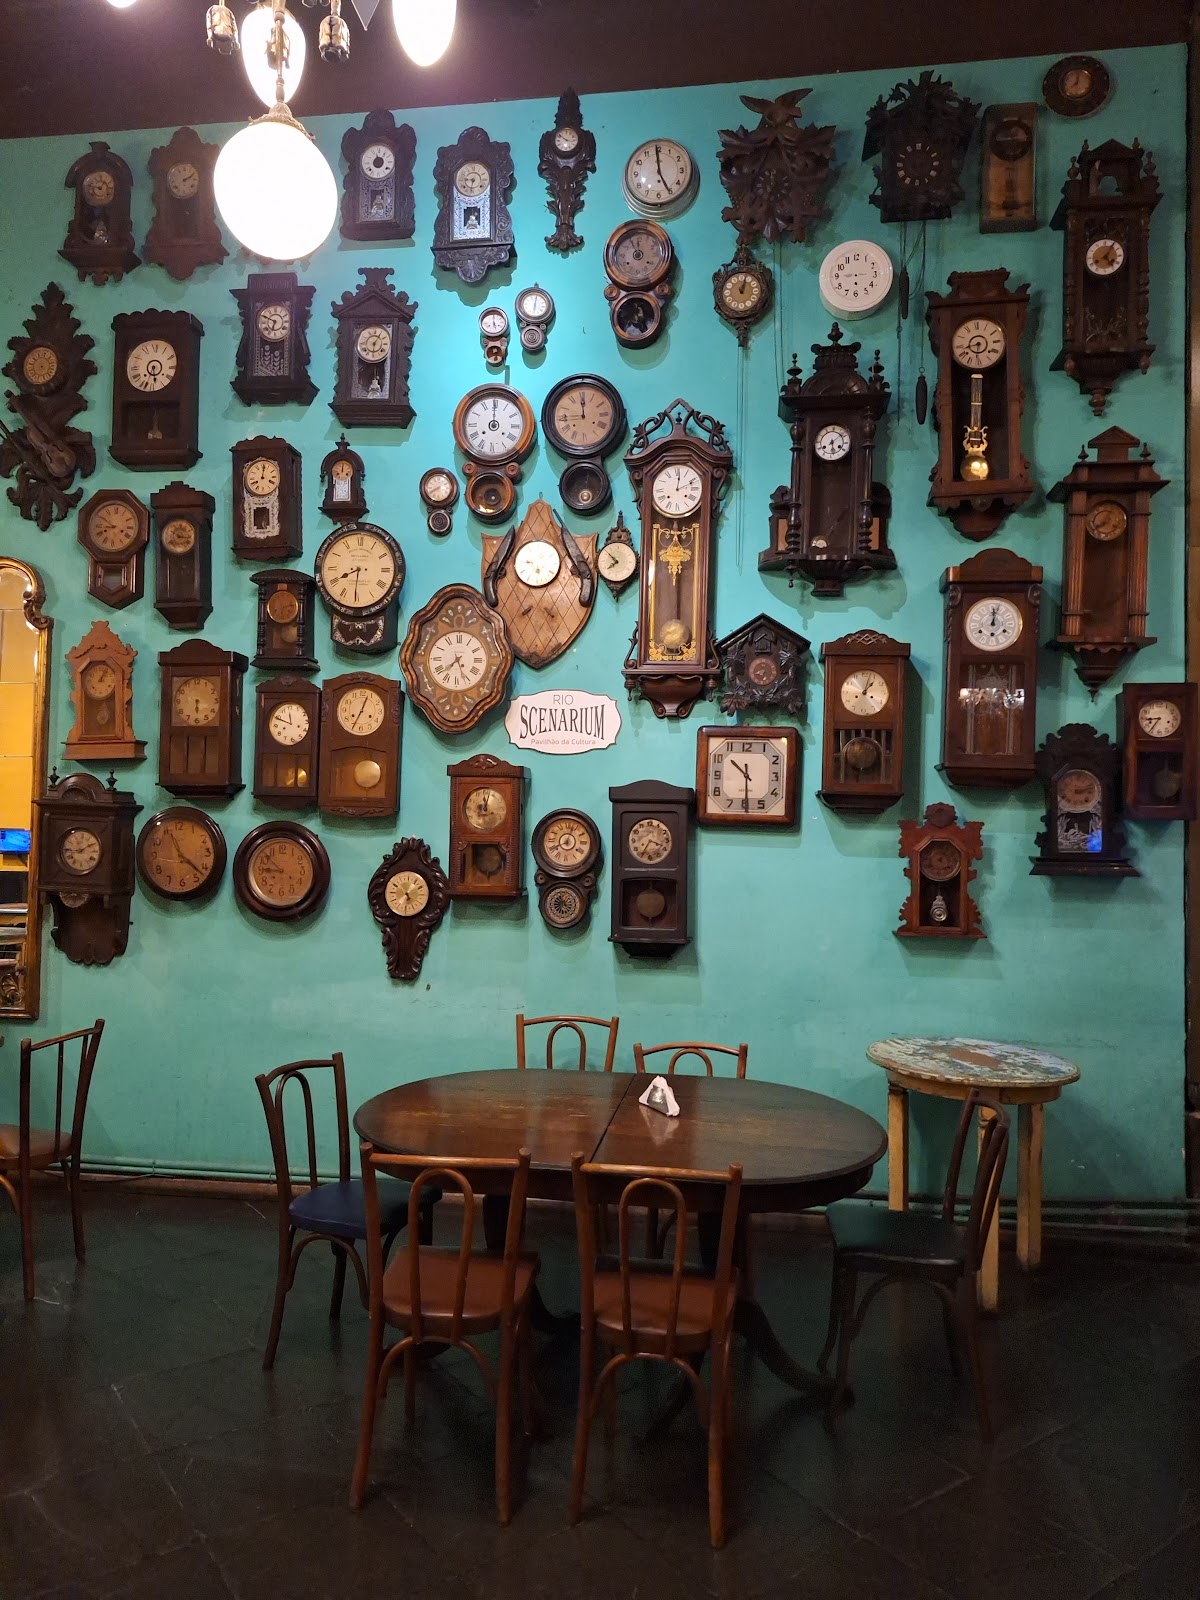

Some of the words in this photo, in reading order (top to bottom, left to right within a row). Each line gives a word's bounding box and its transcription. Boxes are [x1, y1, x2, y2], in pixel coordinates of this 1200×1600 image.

[870, 262, 875, 270] 2
[553, 694, 573, 705] RIO
[520, 704, 605, 740] SCENARIUM
[726, 742, 733, 752] 11
[742, 742, 752, 752] 12
[762, 743, 766, 753] 1
[713, 754, 723, 764] 10
[772, 755, 779, 765] 2
[714, 770, 721, 780] 9
[771, 772, 779, 782] 3
[713, 787, 721, 797] 8
[770, 787, 778, 798] 4
[726, 799, 734, 808] 7
[757, 800, 765, 809] 5
